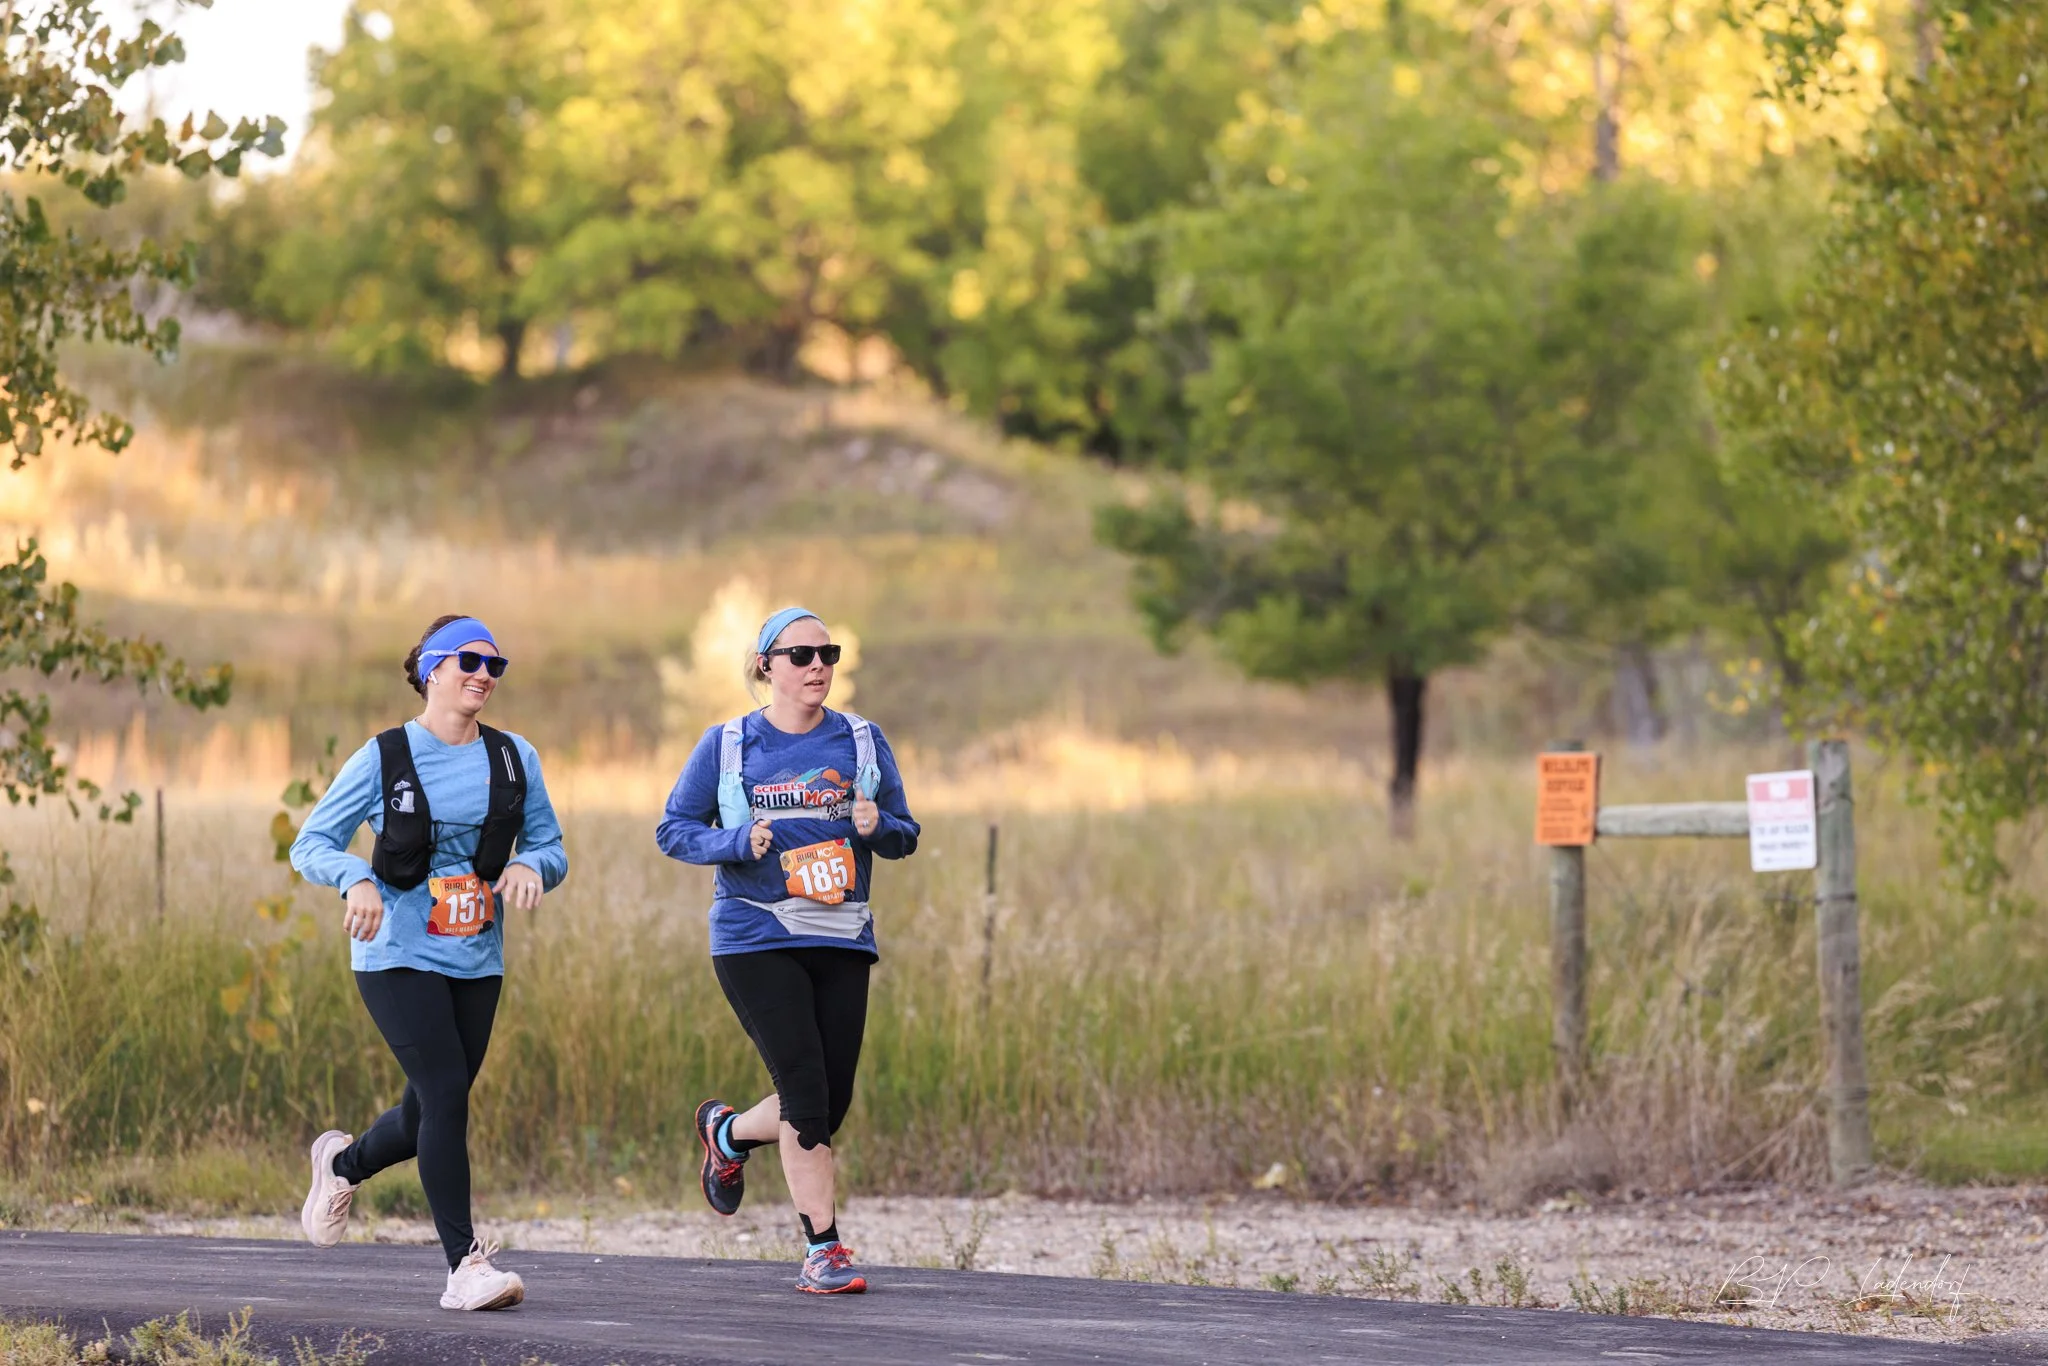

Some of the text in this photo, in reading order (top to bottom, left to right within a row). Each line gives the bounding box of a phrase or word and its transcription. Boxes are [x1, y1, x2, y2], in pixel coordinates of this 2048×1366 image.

[754, 783, 805, 793] SCHEELS
[796, 857, 848, 896] 185
[445, 889, 485, 925] 151
